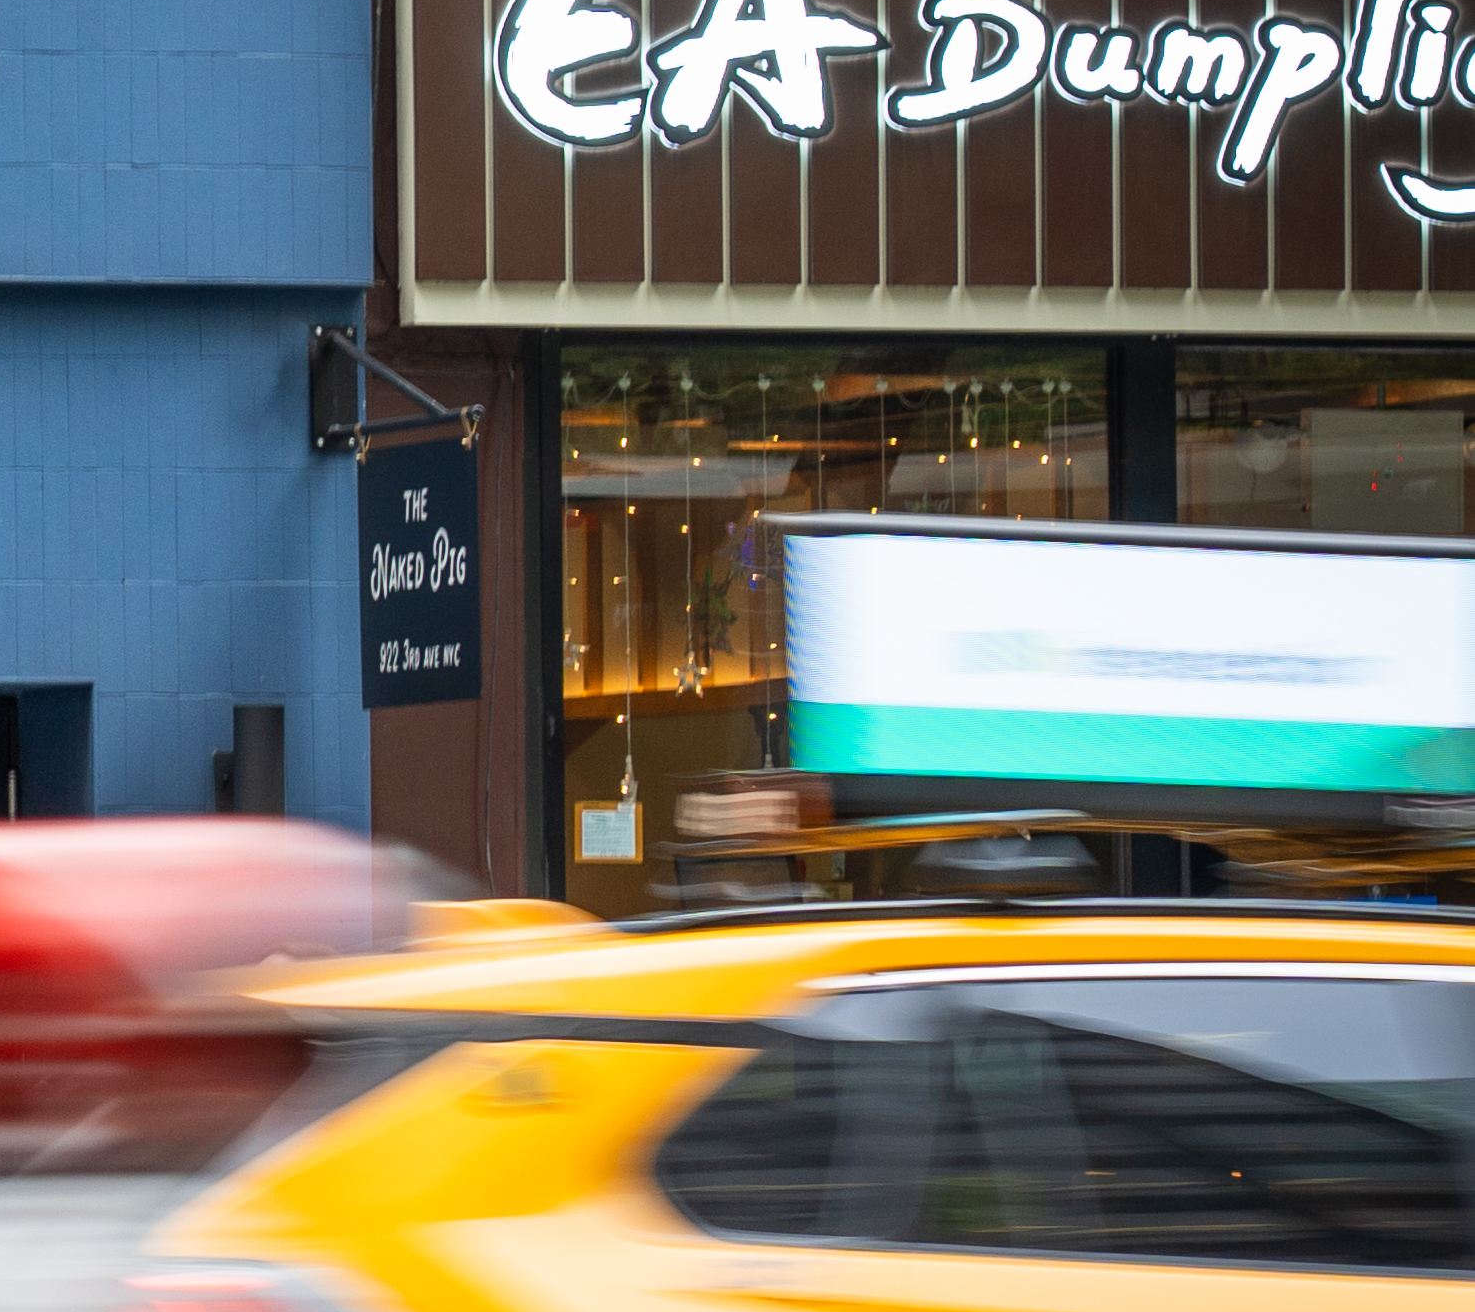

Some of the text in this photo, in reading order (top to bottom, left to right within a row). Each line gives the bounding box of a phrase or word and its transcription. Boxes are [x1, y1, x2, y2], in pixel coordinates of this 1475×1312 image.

[404, 487, 428, 523] THE
[371, 527, 466, 601] NAKED PIG
[379, 638, 461, 674] 922 3RD AVE NYC
